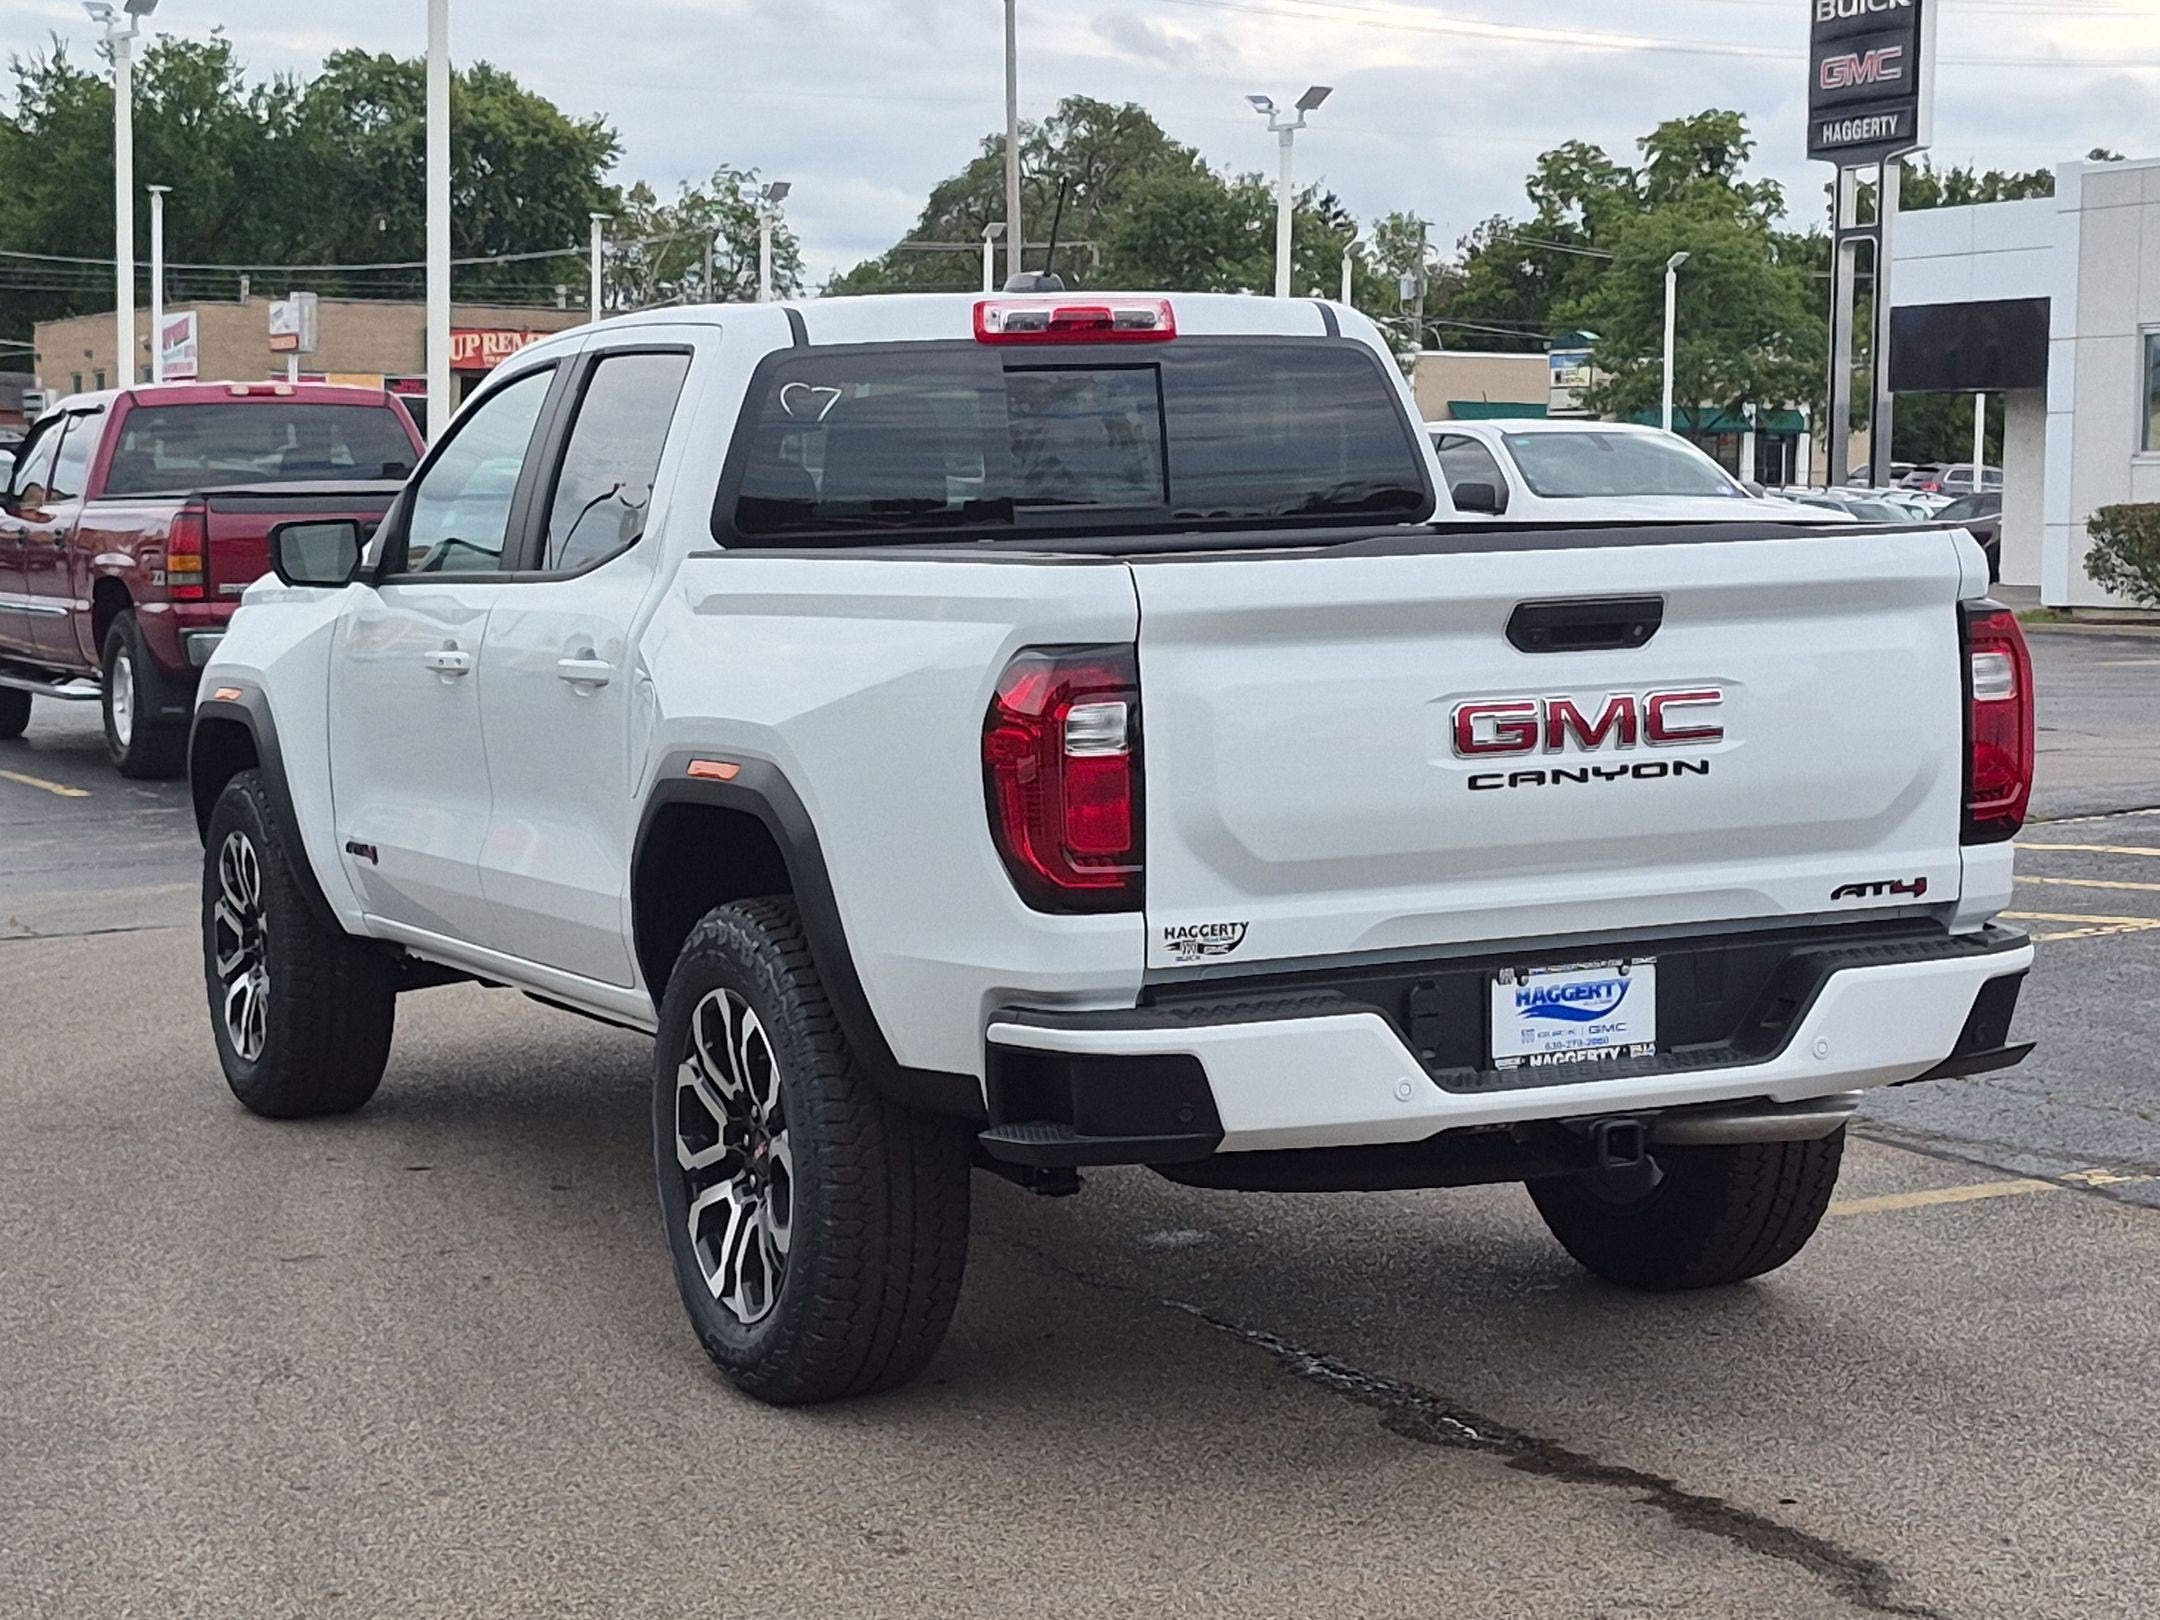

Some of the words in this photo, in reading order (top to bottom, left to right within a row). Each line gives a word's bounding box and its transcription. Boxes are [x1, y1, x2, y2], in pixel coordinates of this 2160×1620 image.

[1820, 45, 1902, 89] GMC
[1822, 114, 1898, 143] HAGGERTY
[450, 332, 548, 361] UPREM
[1450, 687, 1724, 760] GMC
[1468, 759, 1710, 790] CANYON
[1830, 876, 1927, 901] AT4
[1163, 921, 1249, 941] HAGGERTY
[1515, 978, 1632, 1007] HAGGERTY
[1588, 1022, 1628, 1035] GMC
